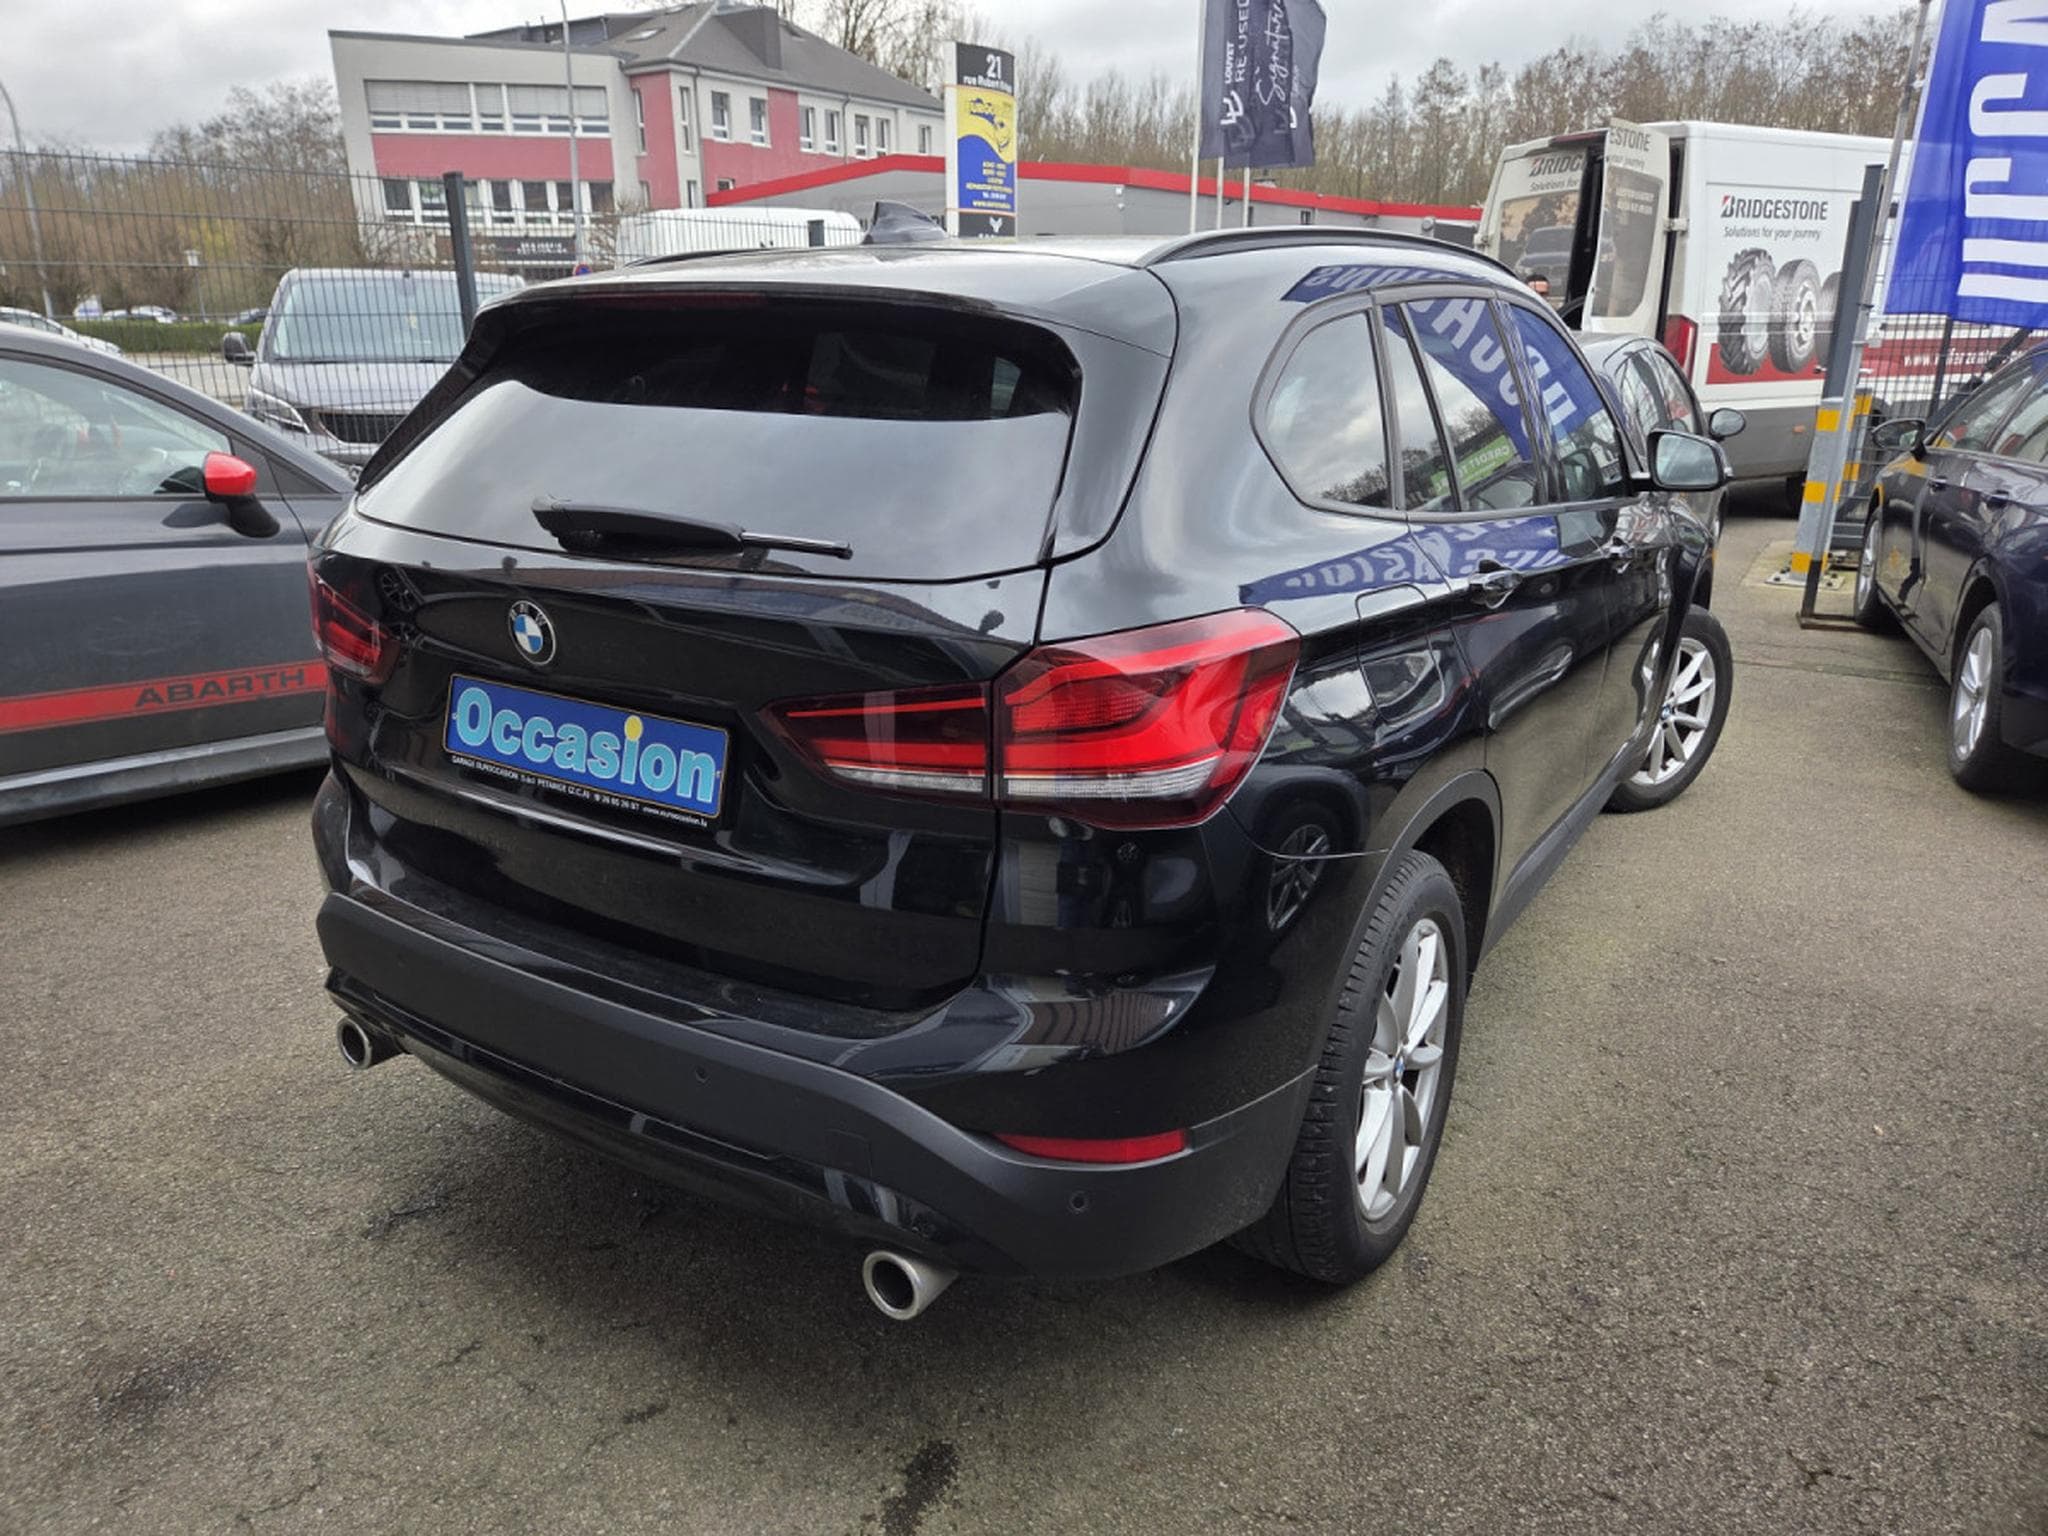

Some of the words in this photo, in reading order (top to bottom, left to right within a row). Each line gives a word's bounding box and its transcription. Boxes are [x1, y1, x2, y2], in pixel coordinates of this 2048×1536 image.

[986, 53, 1002, 80] 21
[1720, 195, 1828, 220] BRIDGESTONE
[1723, 226, 1760, 238] Solutions
[1773, 229, 1791, 241] your
[1792, 228, 1821, 241] journey
[135, 668, 305, 708] ABARTH
[456, 686, 717, 804] Occasion
